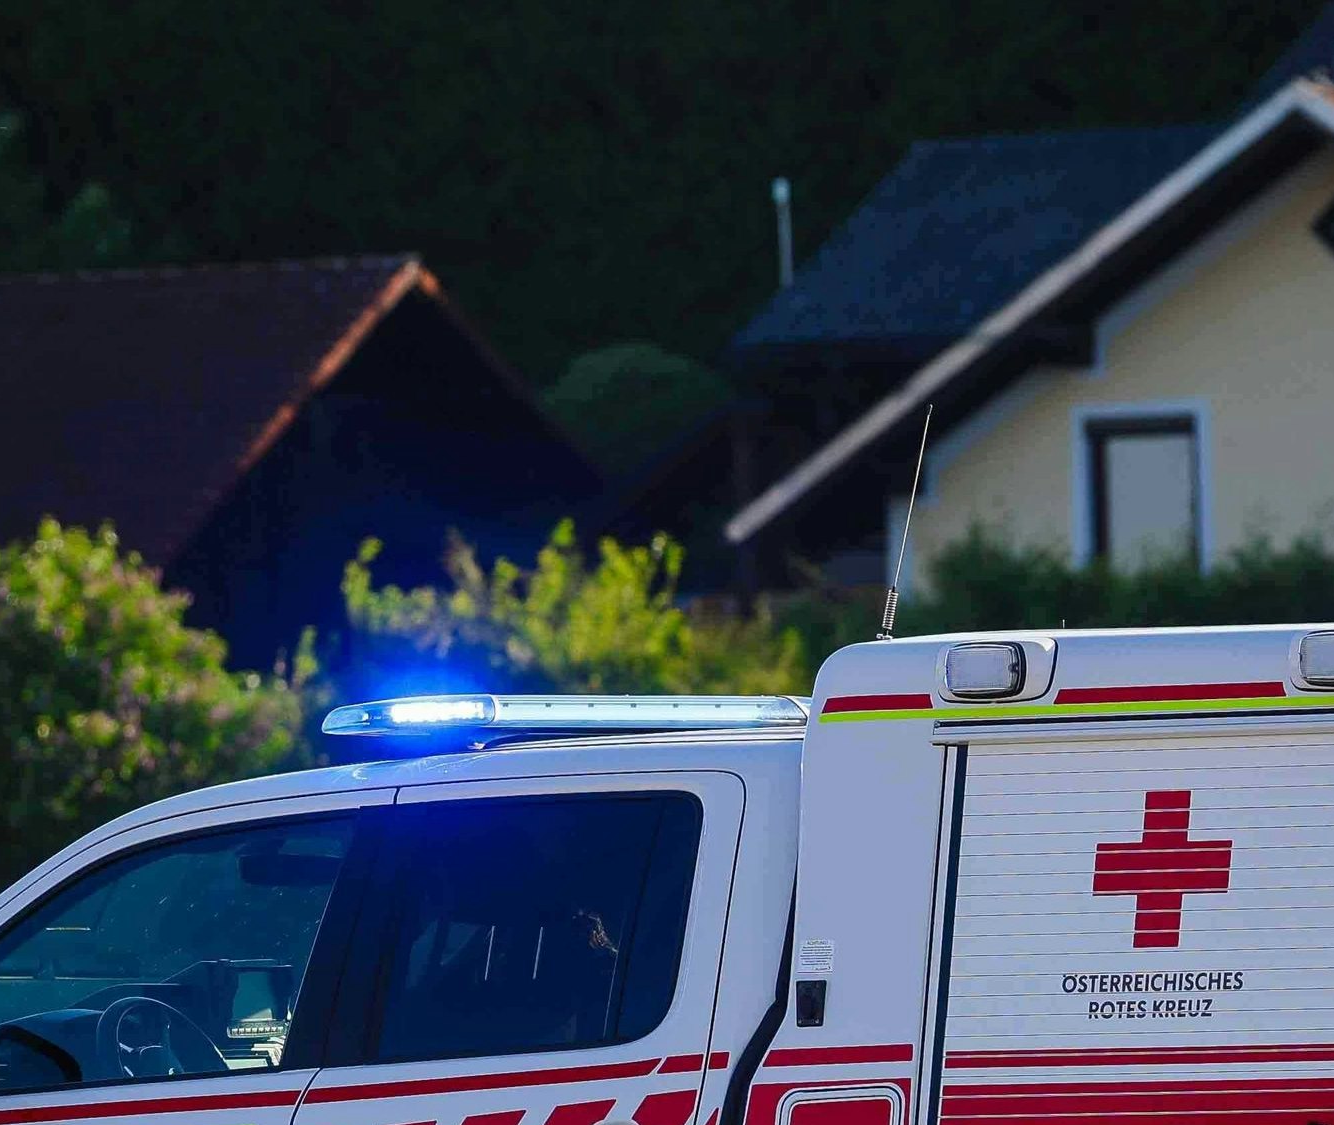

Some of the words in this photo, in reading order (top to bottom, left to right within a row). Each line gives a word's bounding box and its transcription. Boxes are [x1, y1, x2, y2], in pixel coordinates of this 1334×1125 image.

[1062, 971, 1244, 993] ÖSTERREICHISCHES
[1088, 1000, 1147, 1019] ROTES
[1152, 999, 1213, 1017] KREUZ
